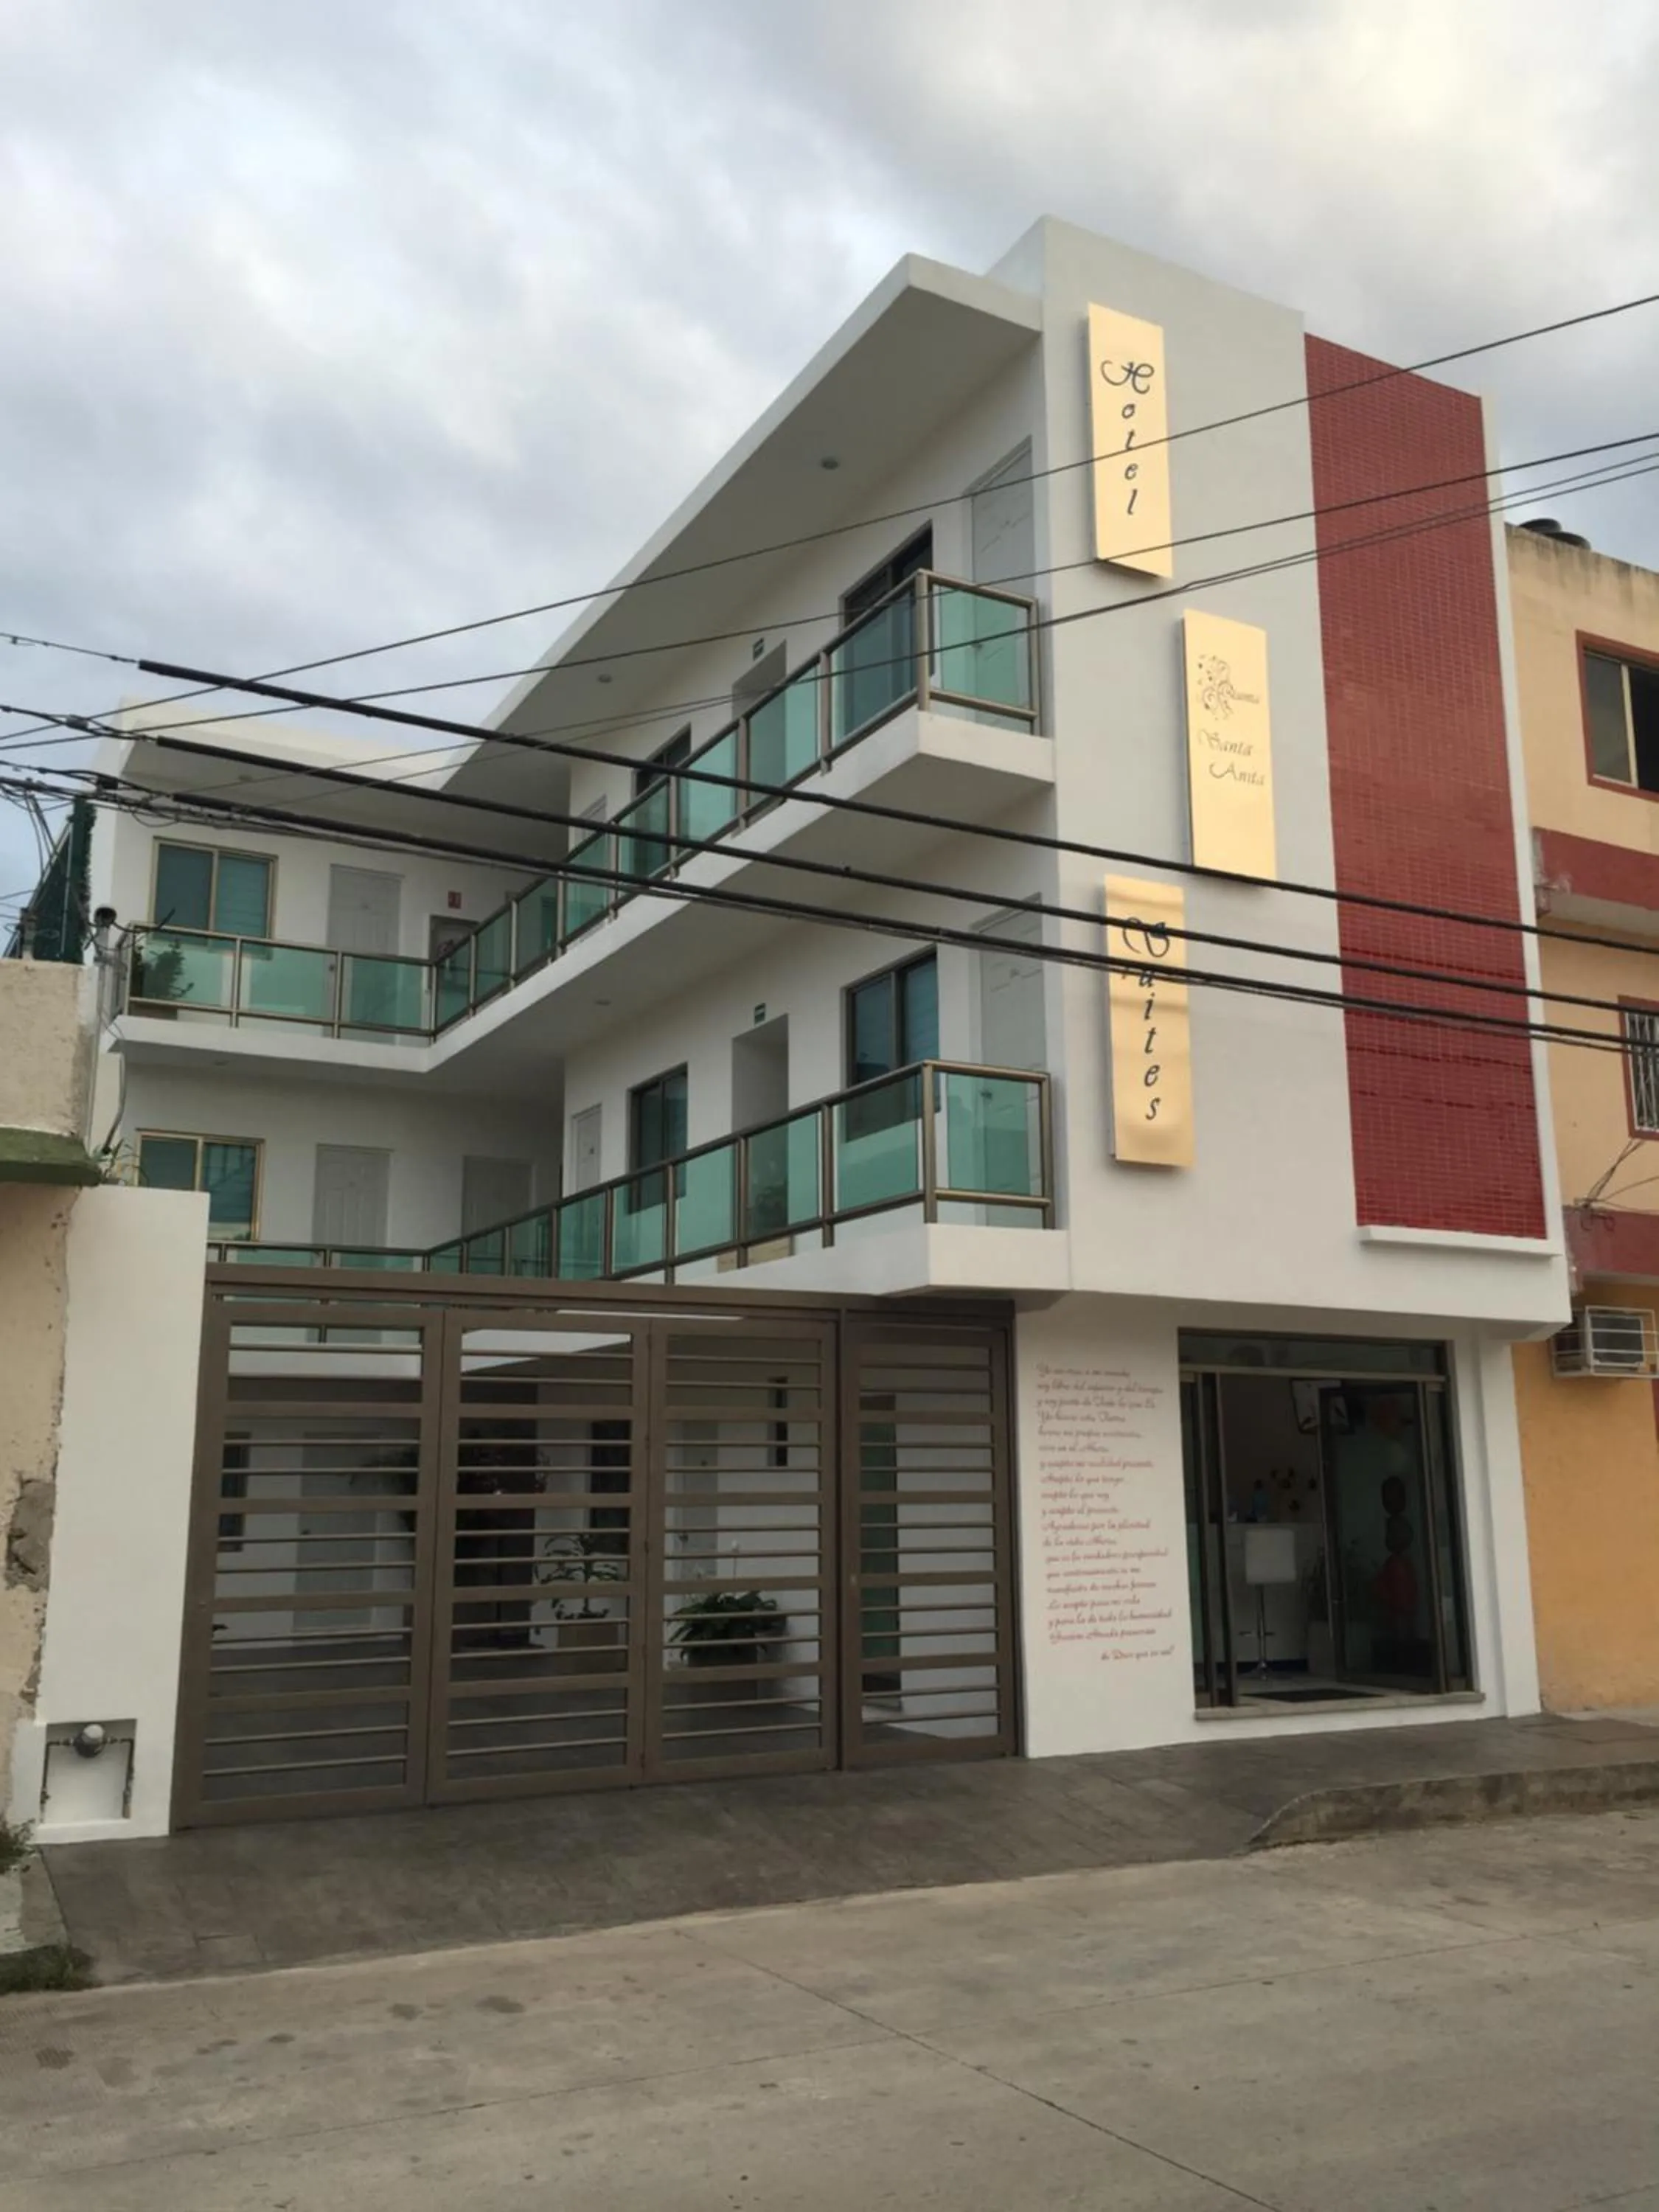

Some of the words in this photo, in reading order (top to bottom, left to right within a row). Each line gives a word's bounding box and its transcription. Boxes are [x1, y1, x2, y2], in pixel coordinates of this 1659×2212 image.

[1100, 358, 1155, 516] Hotel
[1197, 728, 1253, 757] Santa
[1208, 761, 1265, 786] Anita
[1122, 917, 1170, 1121] Suites
